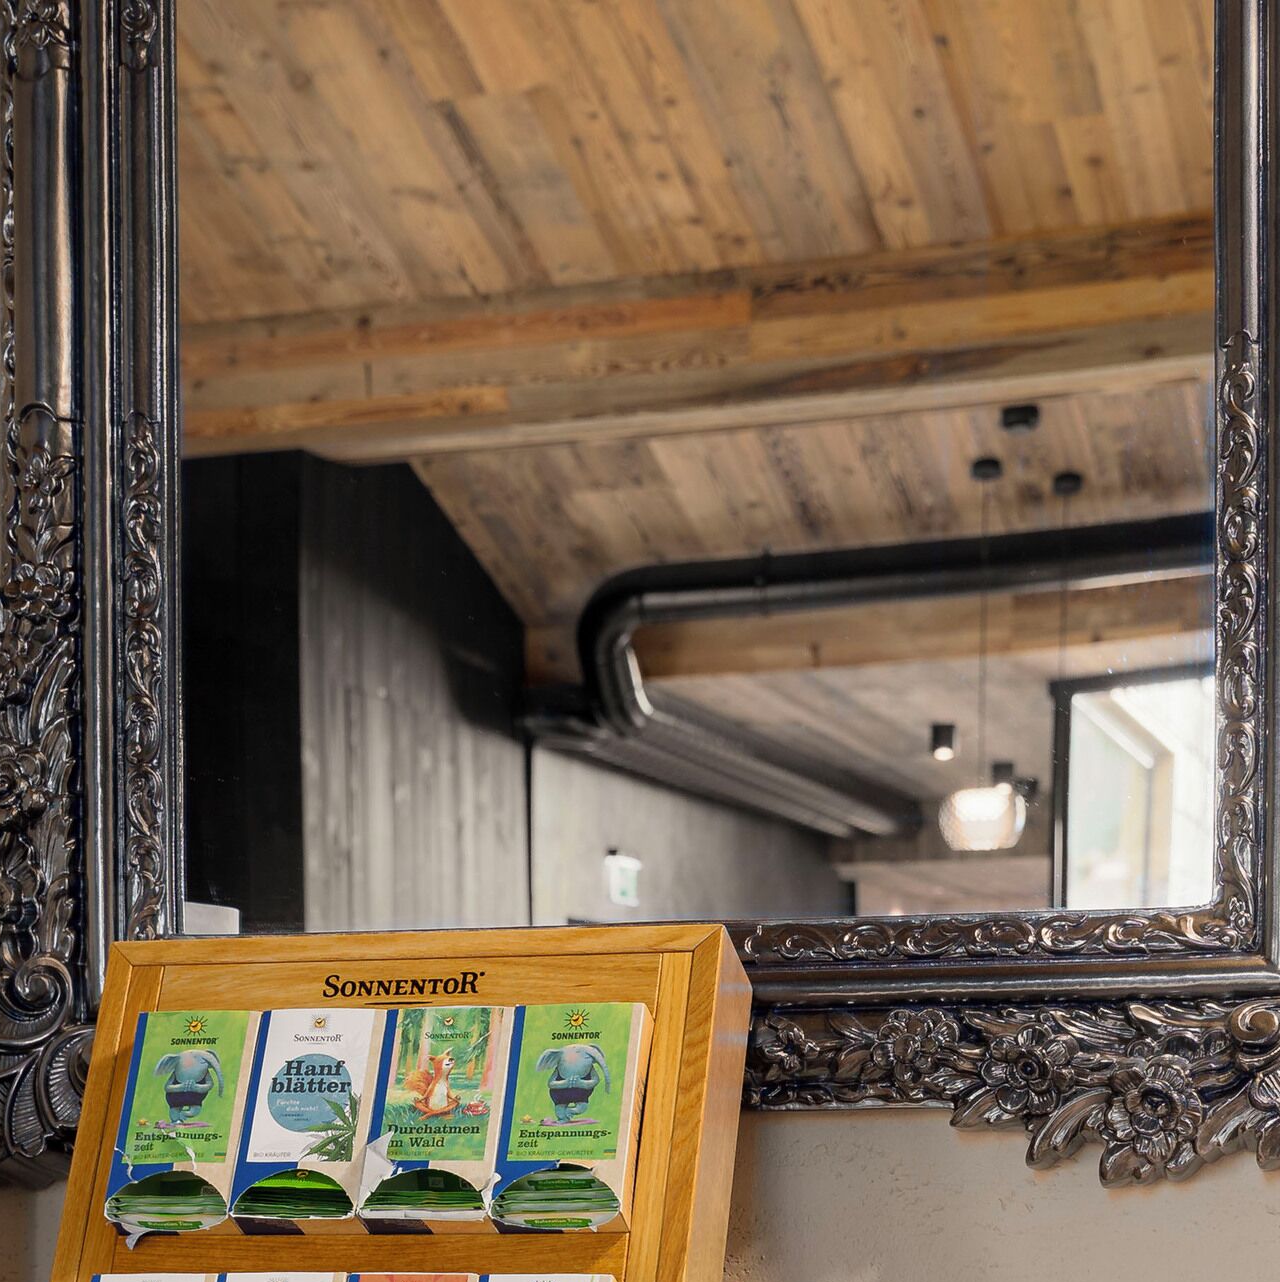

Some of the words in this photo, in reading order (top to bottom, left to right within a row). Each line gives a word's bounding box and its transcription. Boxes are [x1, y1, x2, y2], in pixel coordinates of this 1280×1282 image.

[322, 972, 484, 997] SONNENTOR
[293, 1033, 343, 1042] SONNENTOR
[425, 1031, 471, 1039] SONNENTOR
[551, 1031, 601, 1040] SONNENTOR
[170, 1037, 219, 1046] SONNENTOR
[283, 1060, 346, 1077] Hanf
[271, 1077, 351, 1093] blätter
[387, 1123, 480, 1134] Durchatmen
[518, 1129, 612, 1140] Entspannungs-
[134, 1142, 155, 1152] zeit
[388, 1139, 403, 1148] m
[409, 1137, 445, 1148] Wald
[517, 1138, 539, 1148] zeit
